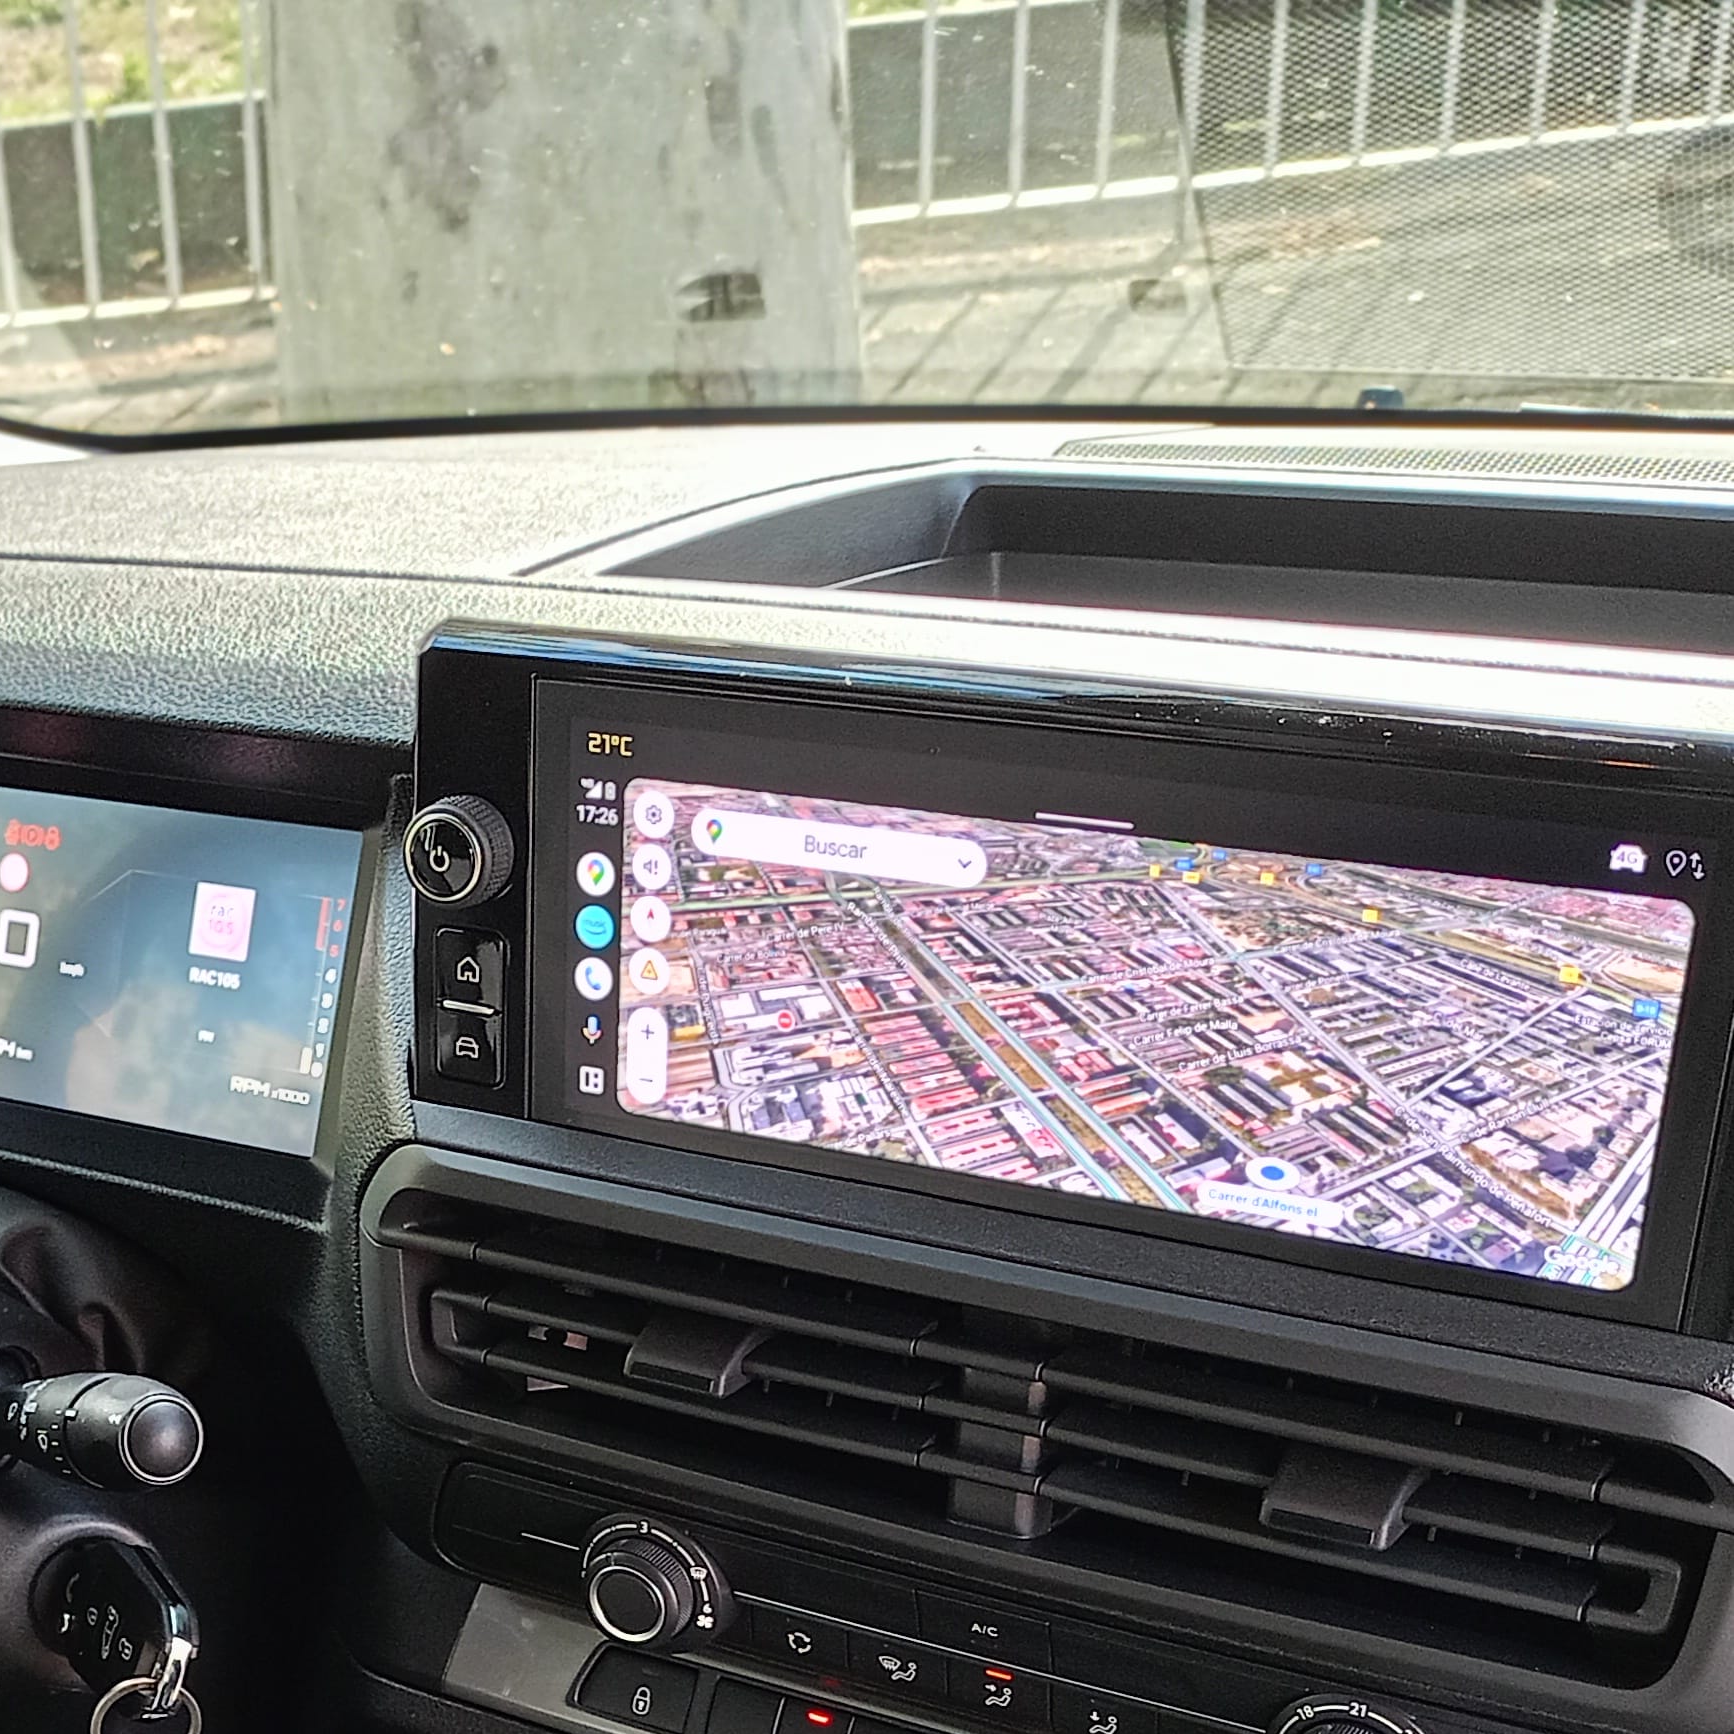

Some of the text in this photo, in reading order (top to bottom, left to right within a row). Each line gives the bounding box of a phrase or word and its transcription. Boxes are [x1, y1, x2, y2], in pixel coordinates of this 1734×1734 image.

[576, 804, 619, 826] 17:26
[804, 834, 868, 859] Buscar
[1617, 852, 1639, 864] 4G
[812, 923, 833, 936] Pere
[847, 902, 909, 969] Rambla de Prim
[189, 967, 241, 989] RAC105
[1133, 1033, 1164, 1046] Carrer
[1194, 1023, 1208, 1034] de
[1209, 1018, 1238, 1033] Malla
[1178, 1060, 1210, 1073] Carrer
[1212, 1054, 1226, 1066] de
[230, 1075, 311, 1105] RPM x1000
[1406, 1116, 1421, 1131] de
[1421, 1128, 1440, 1149] San
[1439, 1145, 1489, 1189] Raimundo
[1488, 1183, 1504, 1199] de
[1504, 1193, 1553, 1227] Peñafort
[1208, 1188, 1318, 1218] Carrer d'Alfons el
[1544, 1245, 1621, 1274] Google
[639, 1521, 649, 1534] 3
[702, 1602, 713, 1614] 6
[971, 1623, 999, 1638] A/C
[1296, 1705, 1315, 1720] 18
[1349, 1702, 1368, 1718] 21
